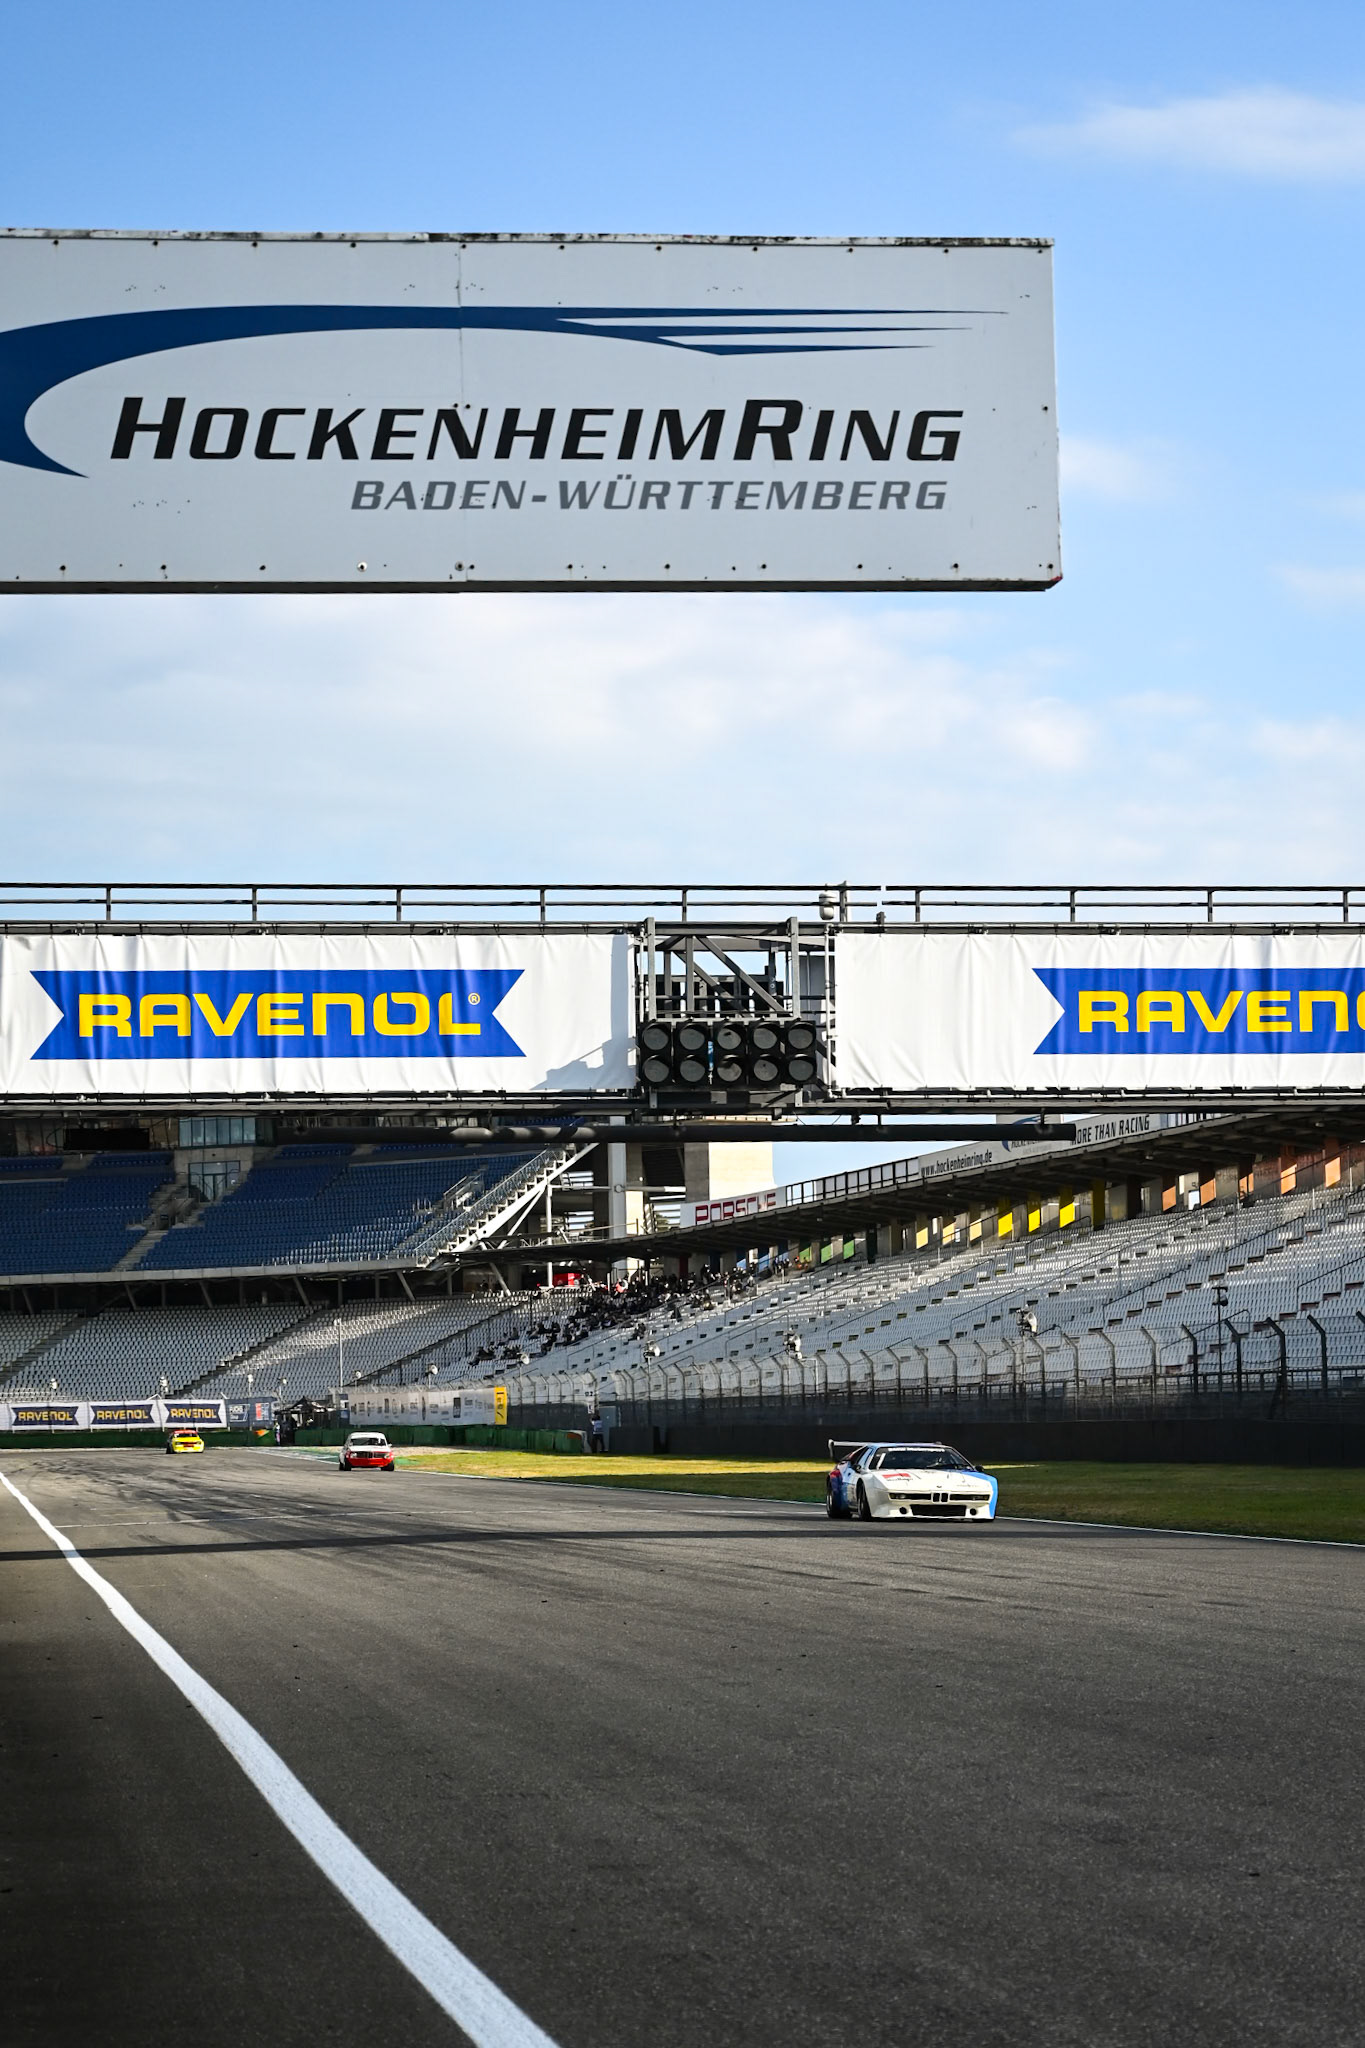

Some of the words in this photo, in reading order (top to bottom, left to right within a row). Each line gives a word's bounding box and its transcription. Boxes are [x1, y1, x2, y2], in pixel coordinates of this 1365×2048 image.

[110, 396, 964, 461] HOCKENHEIMRING
[350, 474, 948, 510] BADEN-WÜRTTEMBERG
[1077, 989, 1365, 1034] RAVEN
[1094, 1121, 1117, 1142] THAN
[1118, 1114, 1150, 1137] RACING
[920, 1149, 993, 1178] www.hockenheimring.de
[17, 1410, 74, 1422] RAVENOL
[96, 1409, 149, 1421] RAVENOL
[170, 1408, 218, 1420] RAVENOL
